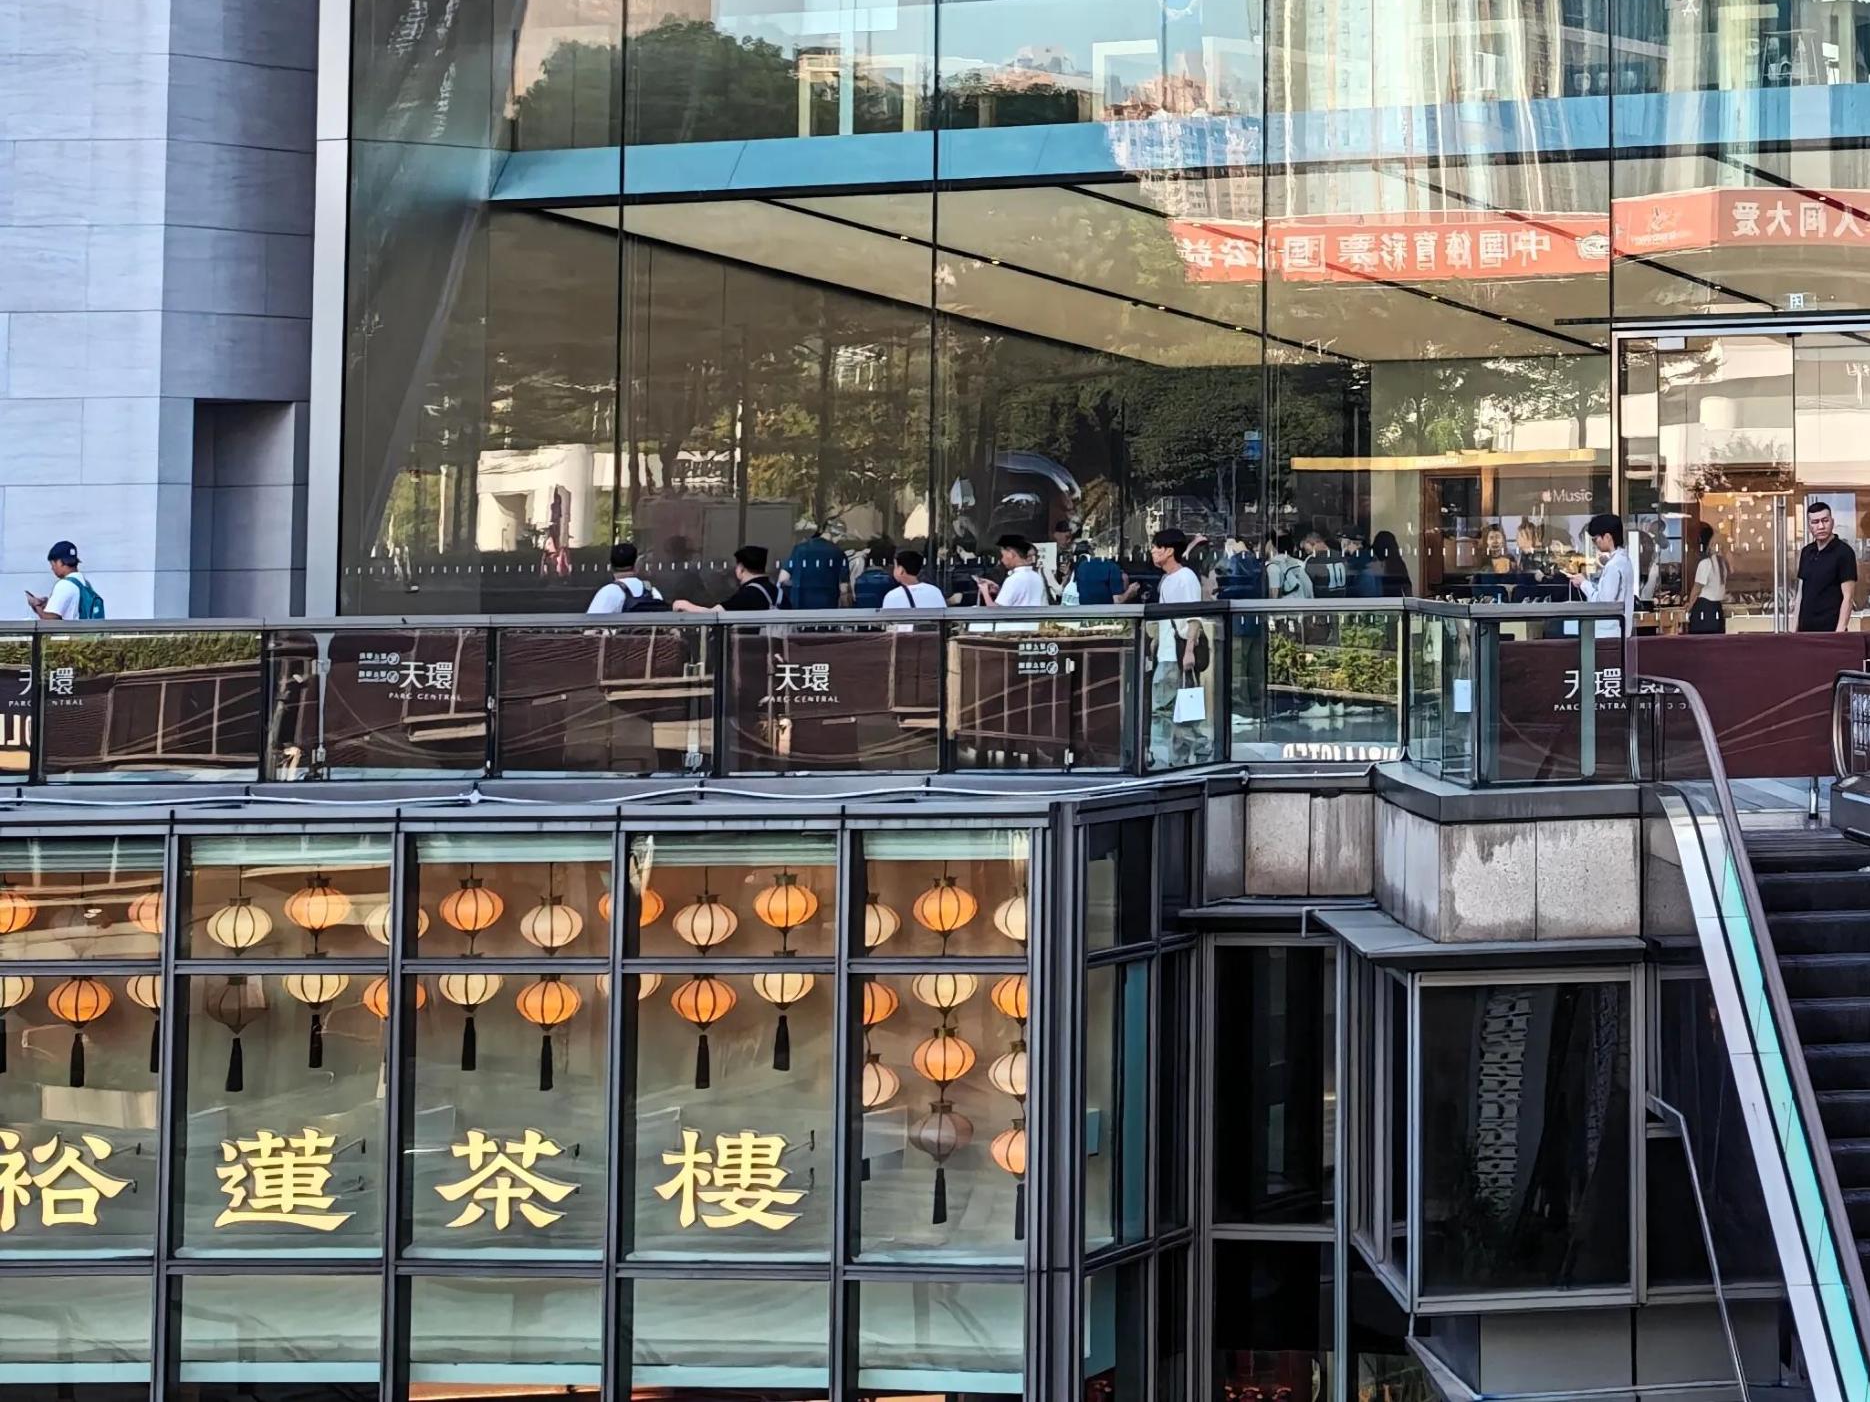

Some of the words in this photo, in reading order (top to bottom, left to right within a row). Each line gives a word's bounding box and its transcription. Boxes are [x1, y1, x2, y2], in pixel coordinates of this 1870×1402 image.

[1553, 488, 1593, 502] Music
[399, 662, 453, 689] 天環
[775, 663, 829, 692] 天環
[388, 692, 413, 700] PARC
[417, 693, 463, 702] CENTRAL
[1554, 703, 1580, 711] PARC
[0, 1127, 806, 1232] 裕蓮茶樓
